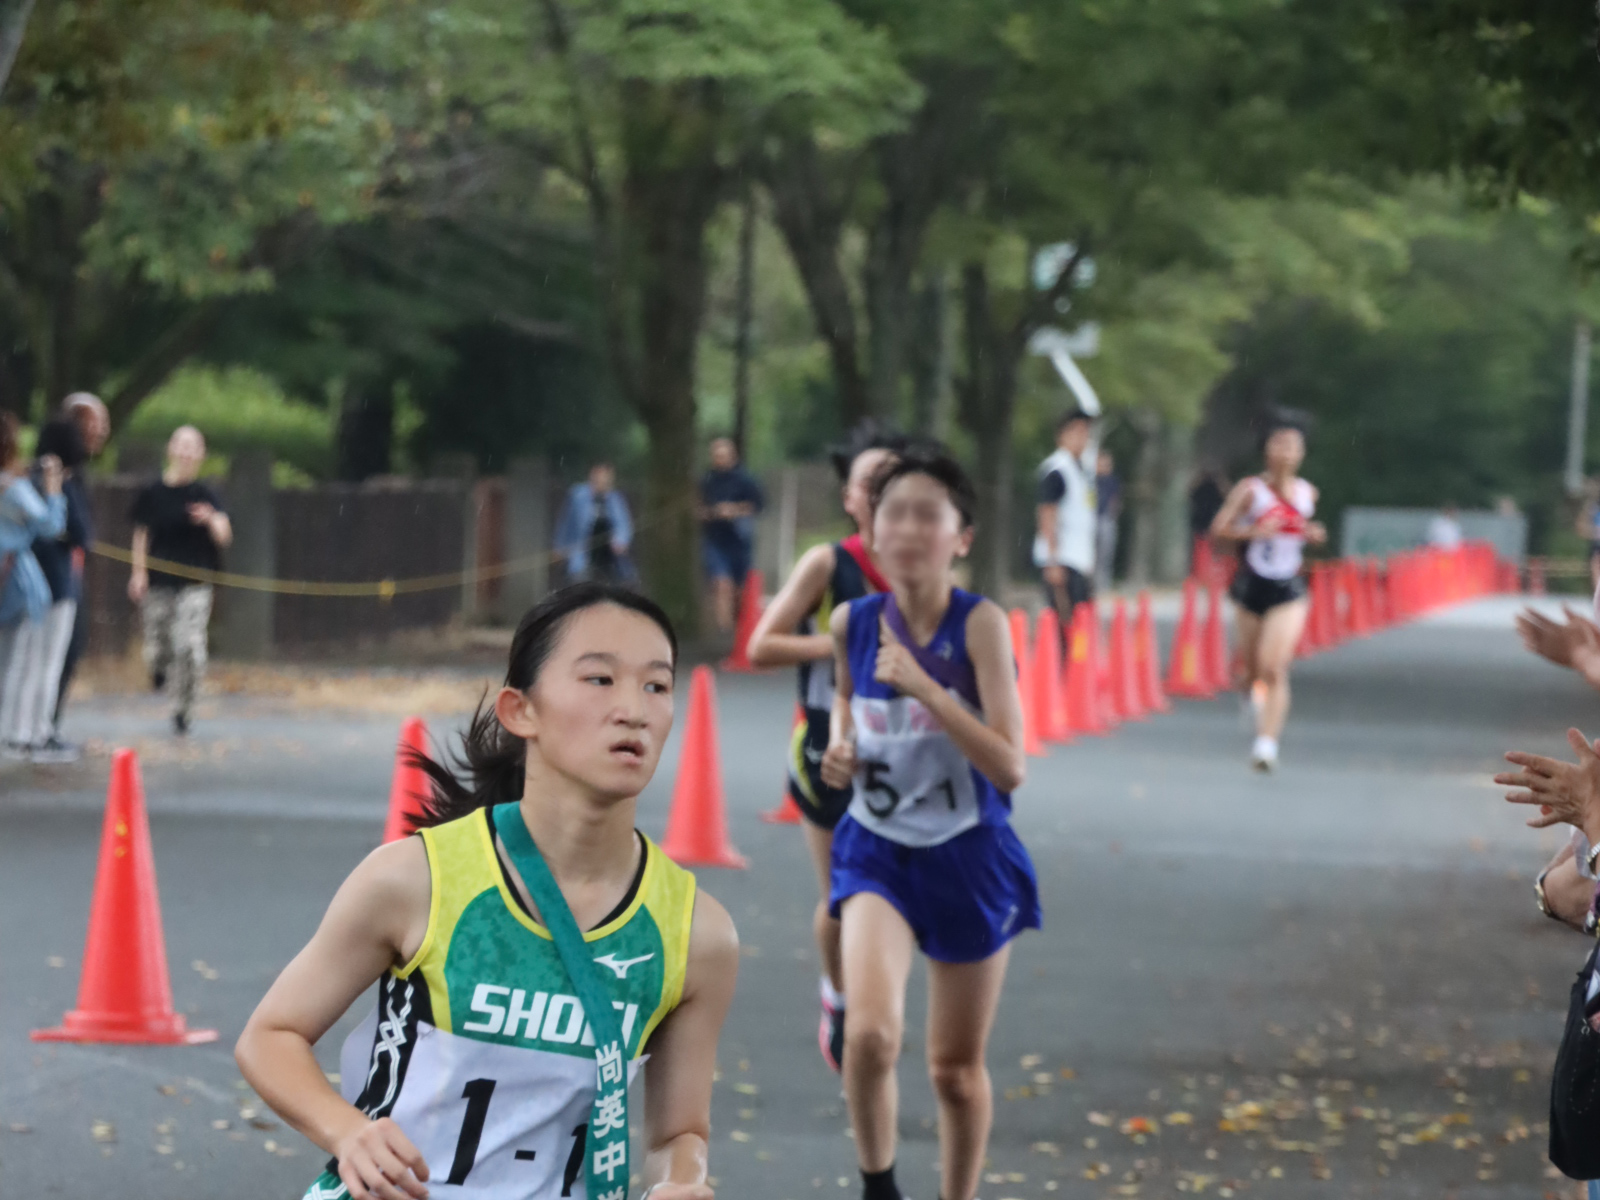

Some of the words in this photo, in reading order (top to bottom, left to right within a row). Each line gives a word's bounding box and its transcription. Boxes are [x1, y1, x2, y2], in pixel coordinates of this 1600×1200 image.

[864, 760, 956, 818] 5-1
[463, 983, 638, 1048] SHOI
[445, 1078, 588, 1197] 1-1
